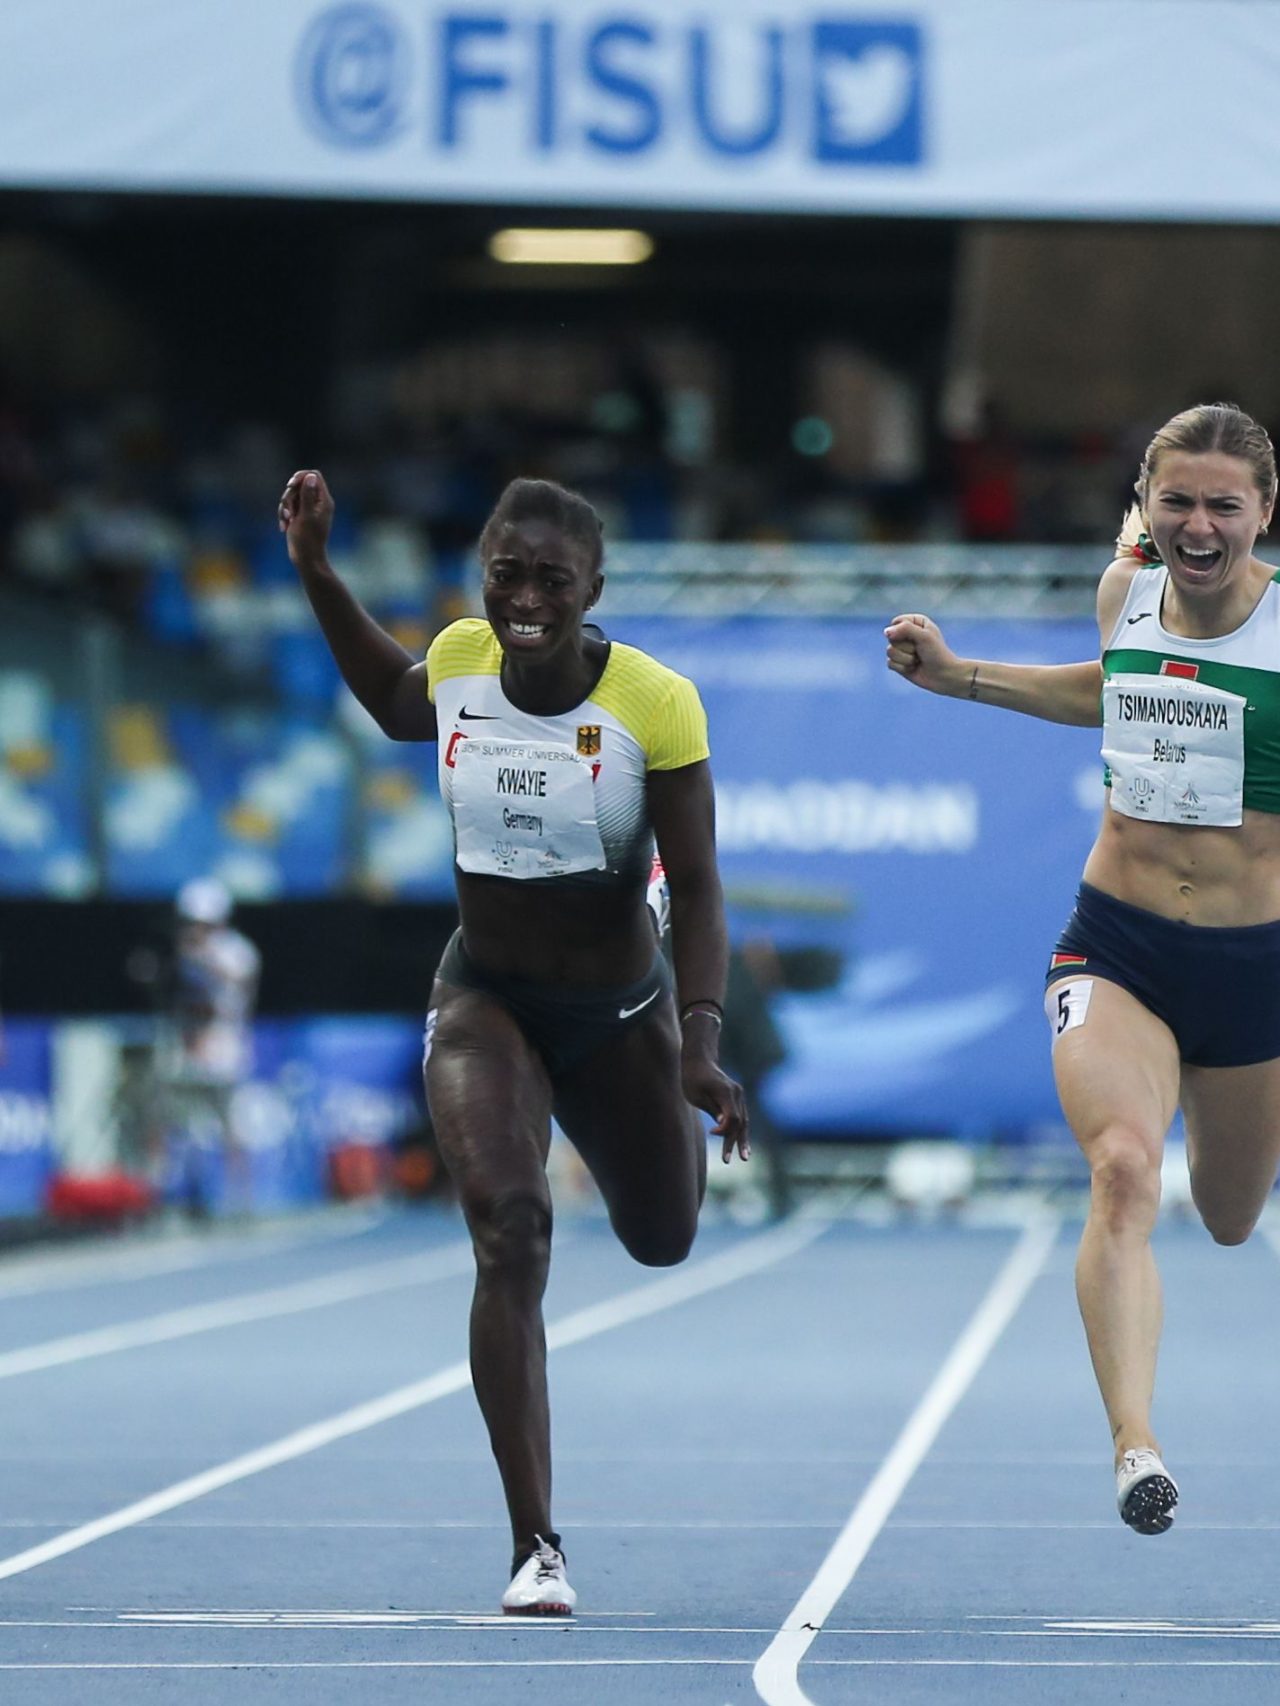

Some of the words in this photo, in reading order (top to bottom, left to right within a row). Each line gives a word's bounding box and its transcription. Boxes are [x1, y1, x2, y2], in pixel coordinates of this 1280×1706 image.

[298, 4, 788, 158] @FISU
[1118, 694, 1228, 731] TSIMANOUSKAYA
[482, 746, 525, 759] SUMMER
[497, 767, 547, 797] KWAYIE
[503, 807, 543, 837] Germany
[1057, 989, 1071, 1034] 5
